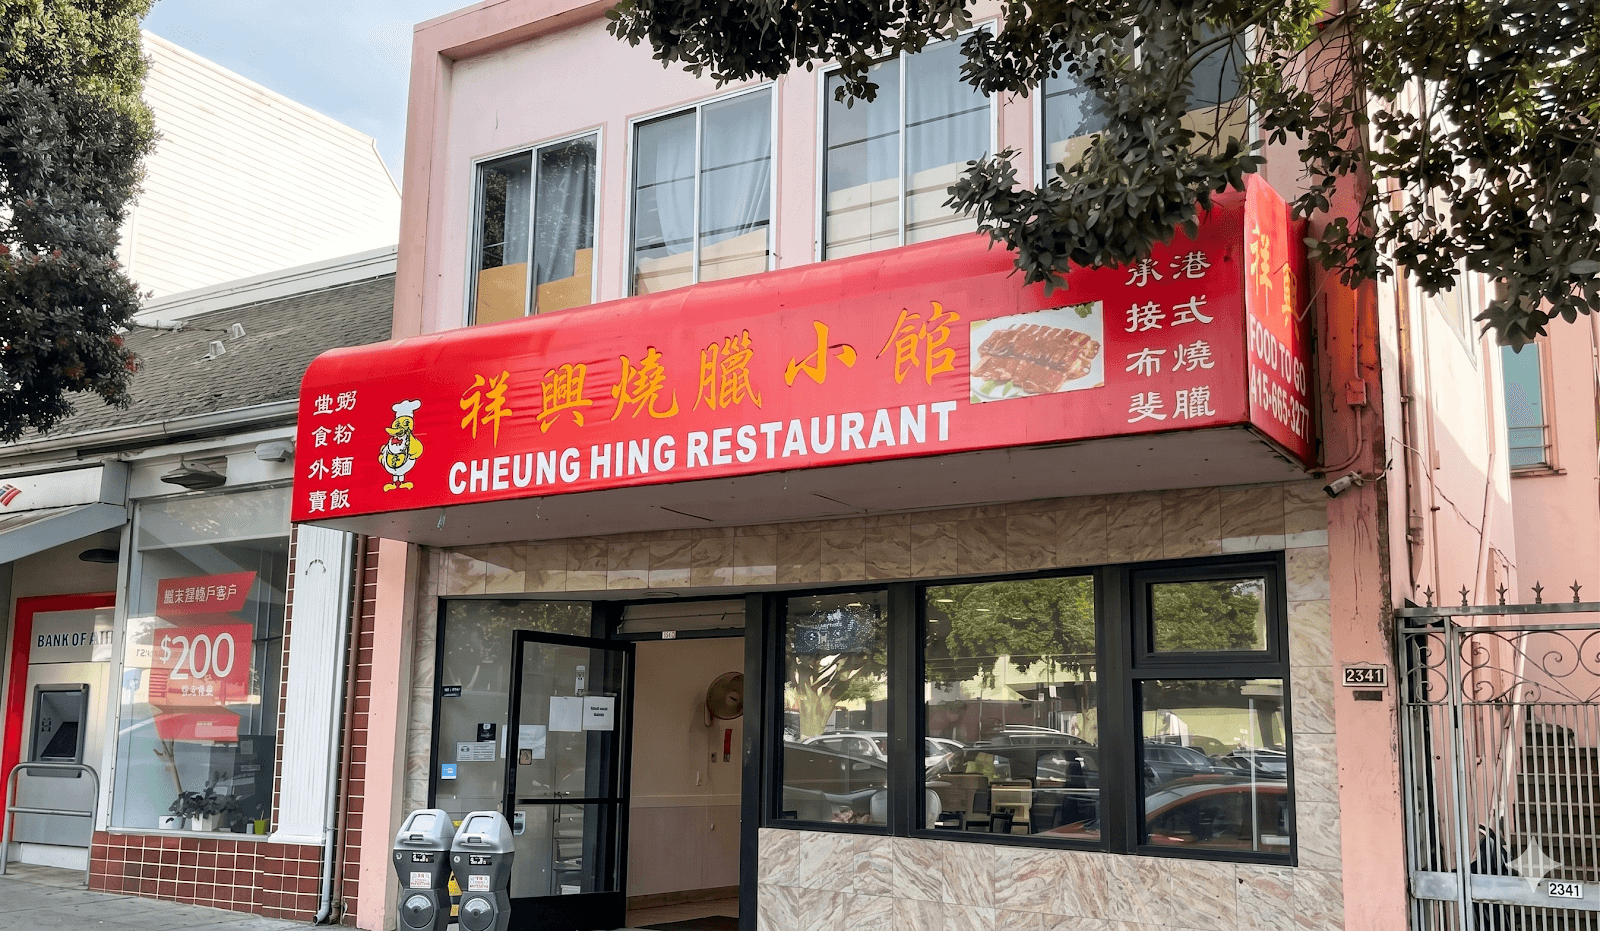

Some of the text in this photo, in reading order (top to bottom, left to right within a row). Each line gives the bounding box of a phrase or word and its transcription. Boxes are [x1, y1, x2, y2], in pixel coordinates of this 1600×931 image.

[459, 301, 960, 447] 祥興燒臘小館
[1250, 312, 1306, 397] FOOD TO GO
[448, 400, 958, 495] CHEUNG HING RESTAURANT
[37, 633, 69, 648] BANK
[71, 632, 87, 646] OF
[159, 633, 235, 680] $200
[1346, 669, 1384, 683] 2341
[1549, 883, 1580, 897] 2341
